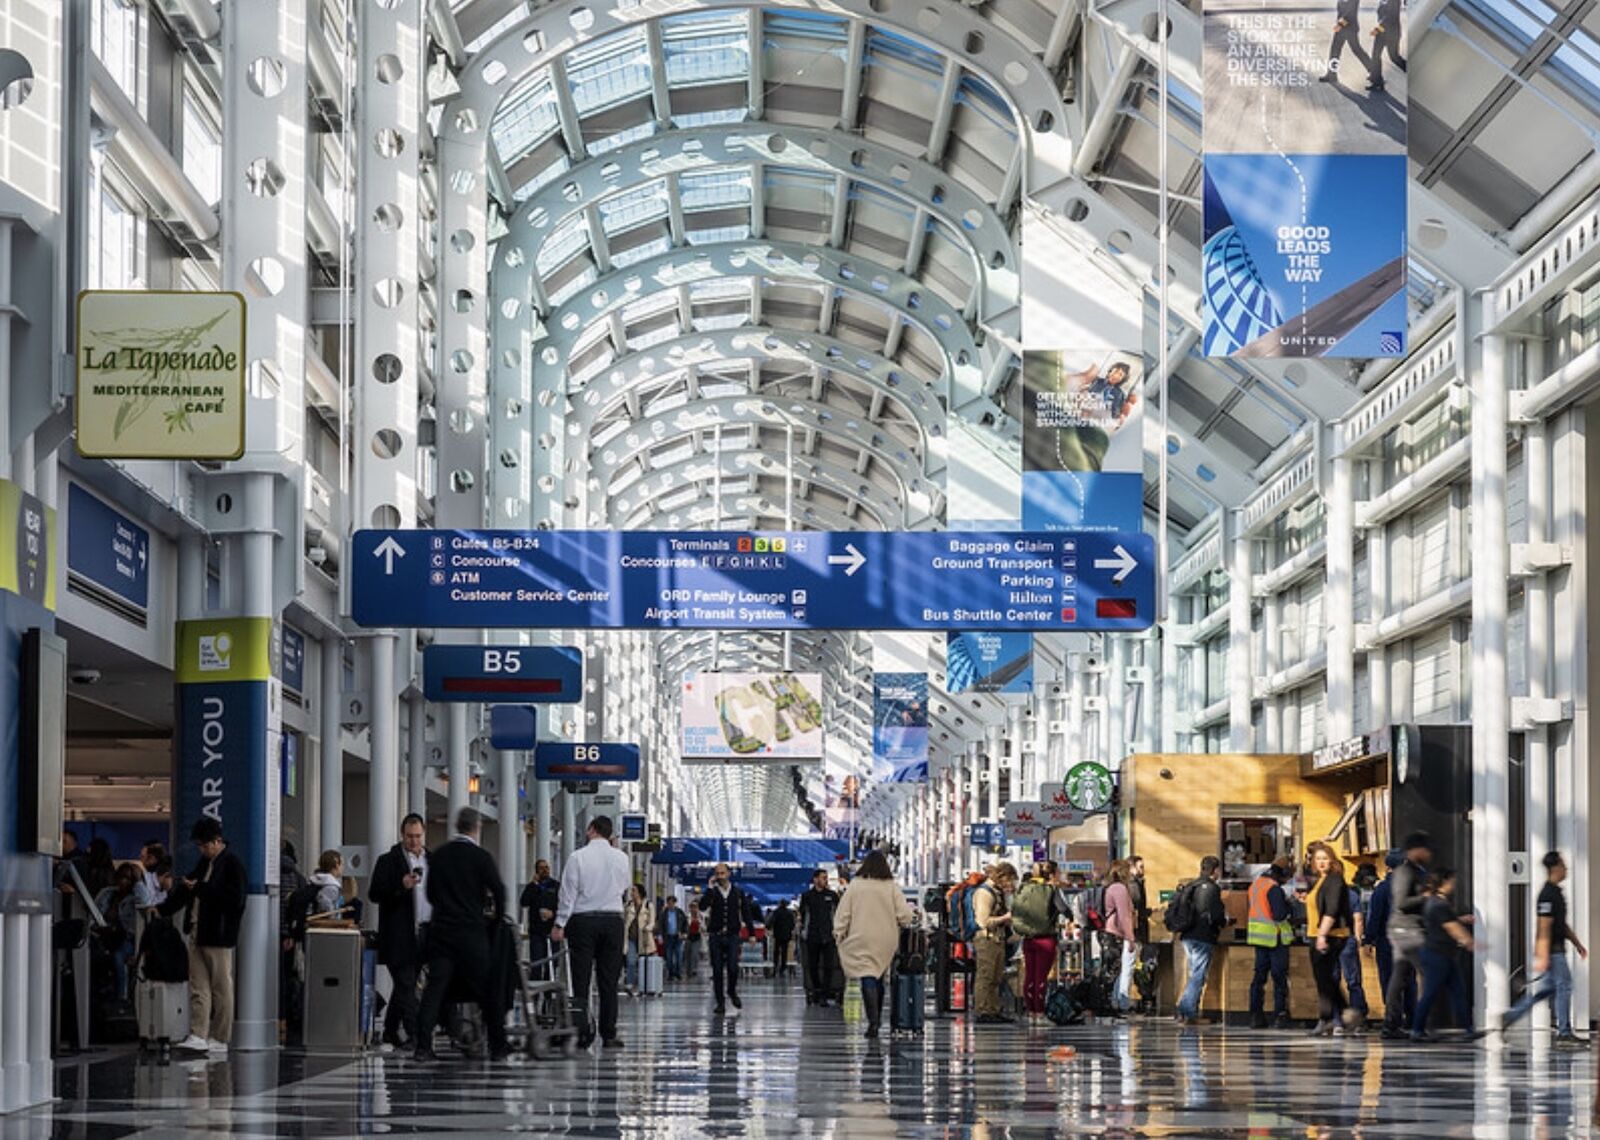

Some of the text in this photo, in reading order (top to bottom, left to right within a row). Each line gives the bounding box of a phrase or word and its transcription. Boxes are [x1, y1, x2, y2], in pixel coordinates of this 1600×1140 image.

[1228, 16, 1316, 29] THIS IS THE
[1227, 30, 1305, 43] STORY OF
[1227, 44, 1317, 57] AN AIRLINE
[1227, 58, 1340, 72] DIVERSIFYING
[1228, 72, 1312, 86] THE SKIES.
[1278, 226, 1330, 239] GOOD
[1277, 240, 1331, 254] LEADS
[1288, 255, 1320, 268] THE
[1284, 269, 1323, 282] WAY
[1280, 336, 1337, 345] UNITED
[83, 344, 238, 379] La Tapenade
[93, 385, 224, 397] MEDITERRANEAN
[184, 398, 225, 414] CAFÉ
[452, 537, 489, 550] Gates
[670, 538, 730, 552] Terminals
[950, 539, 1054, 555] Baggage Claim
[452, 555, 521, 568] Concourse
[620, 556, 697, 569] Concourses
[932, 556, 1053, 572] Ground Transport
[451, 572, 480, 584] ATM
[1001, 574, 1055, 589] Parking
[451, 588, 611, 602] Customer Service Center
[660, 589, 786, 605] ORD Family Lounge
[1010, 591, 1053, 604] Hilton
[645, 607, 786, 623] Airport Transit System
[923, 609, 1053, 622] Bus Shuttle Center
[484, 651, 521, 673] B5
[574, 746, 600, 761] B6
[203, 698, 224, 824] YOU AR
